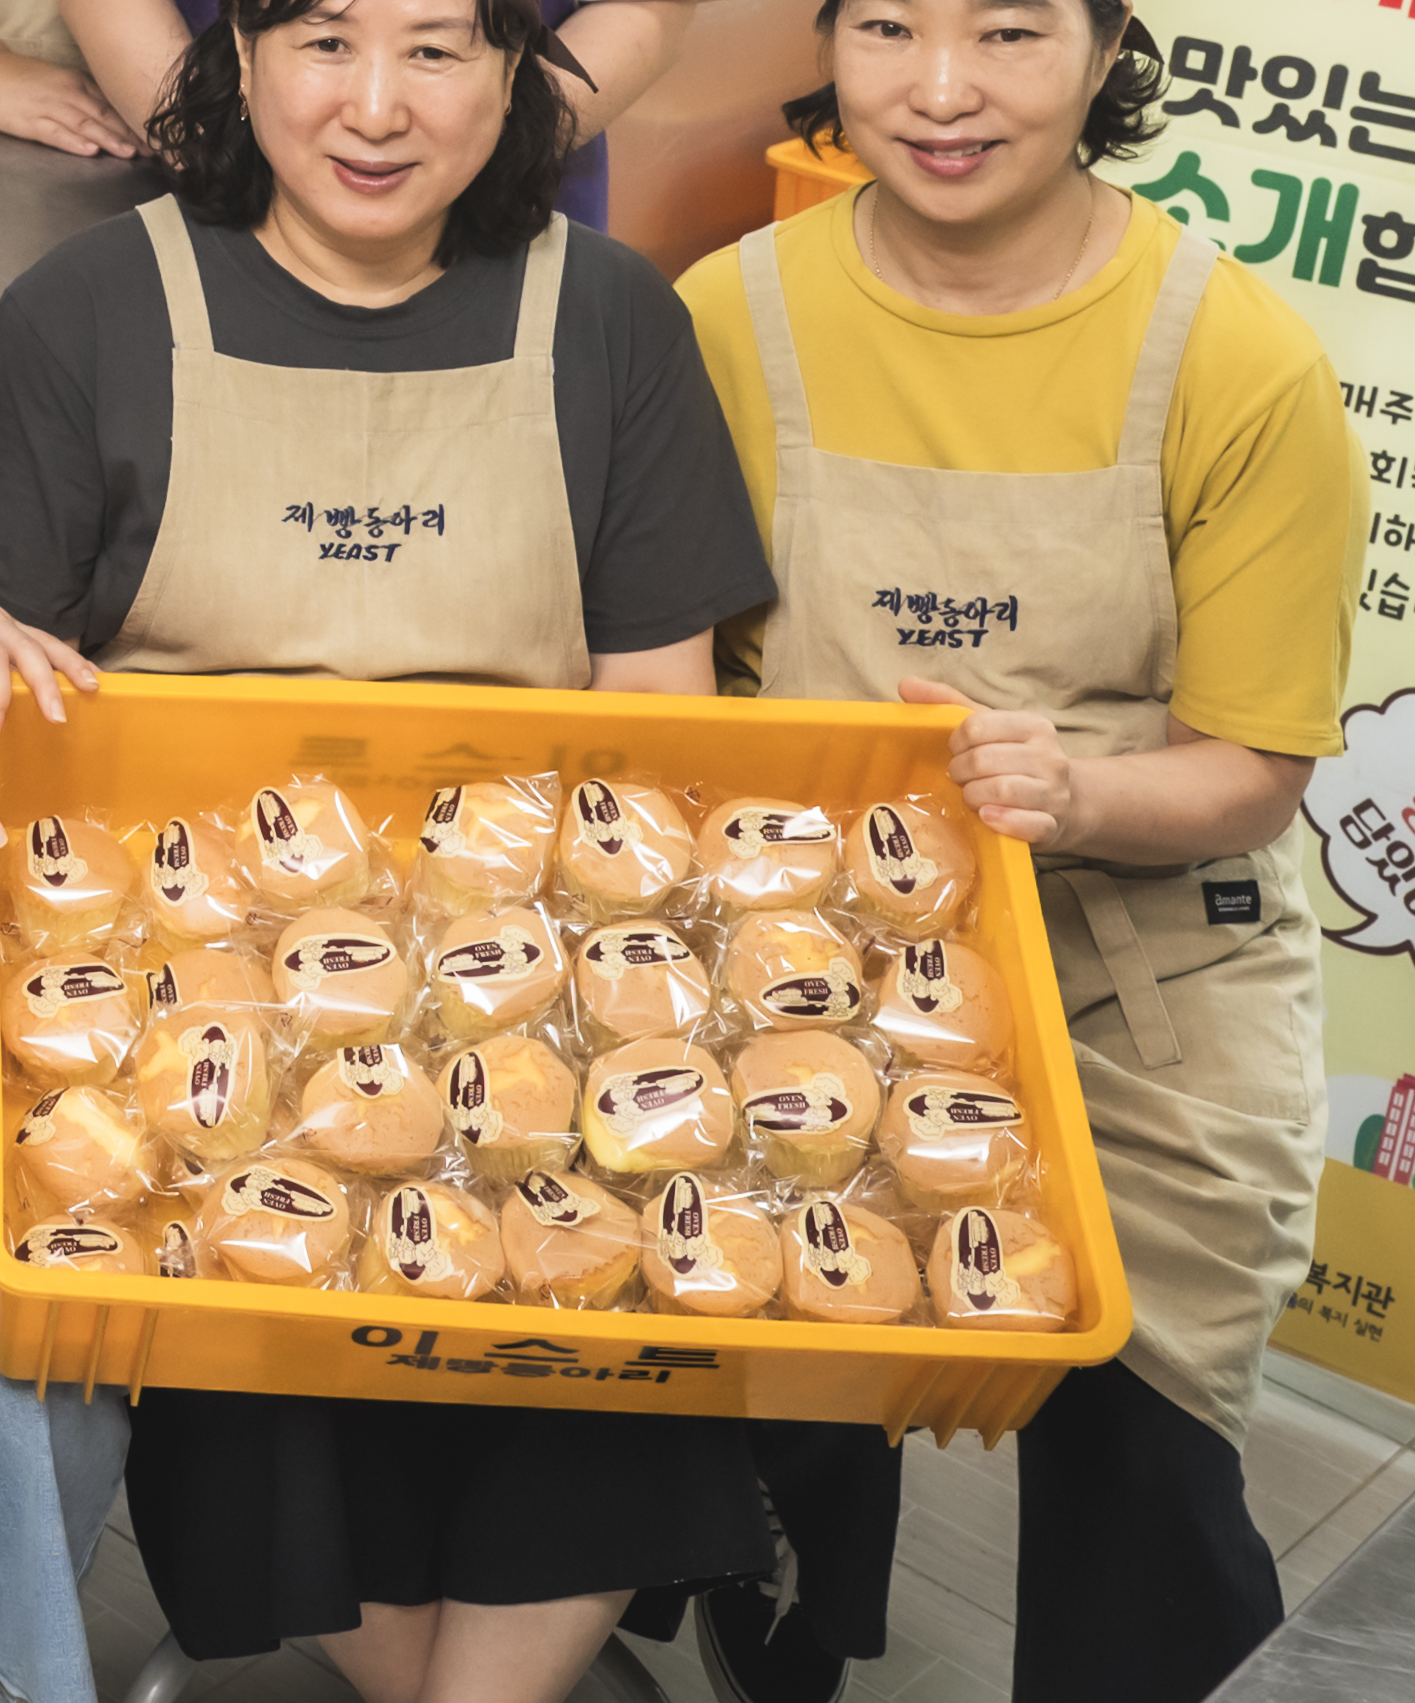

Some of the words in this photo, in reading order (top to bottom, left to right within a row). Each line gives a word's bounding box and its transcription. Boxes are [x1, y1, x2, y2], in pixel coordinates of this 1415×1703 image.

[281, 501, 445, 540] 제빵동아리
[319, 542, 402, 562] YEAST
[872, 587, 1018, 632] 제빵동아리
[896, 627, 989, 648] YEAST
